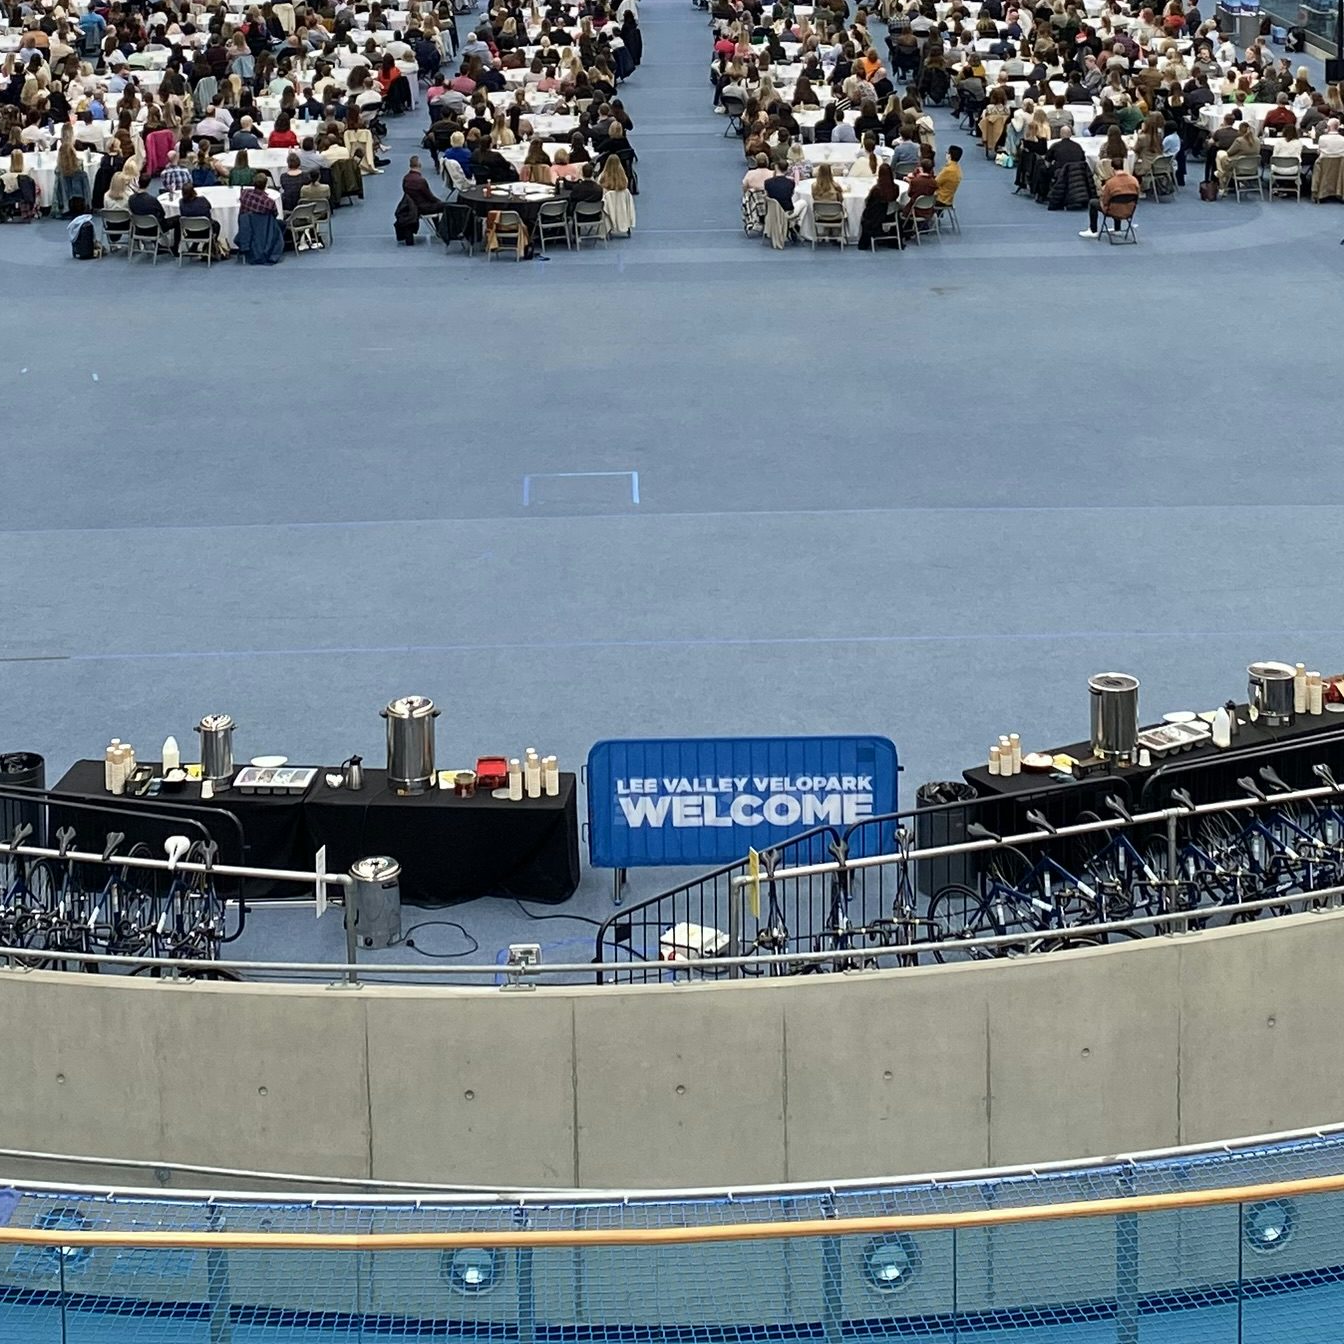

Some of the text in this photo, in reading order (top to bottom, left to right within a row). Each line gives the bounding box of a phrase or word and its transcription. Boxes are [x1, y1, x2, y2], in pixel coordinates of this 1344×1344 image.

[617, 775, 874, 794] LEE VALLEY VELOPARK
[619, 793, 875, 828] WELCOME
